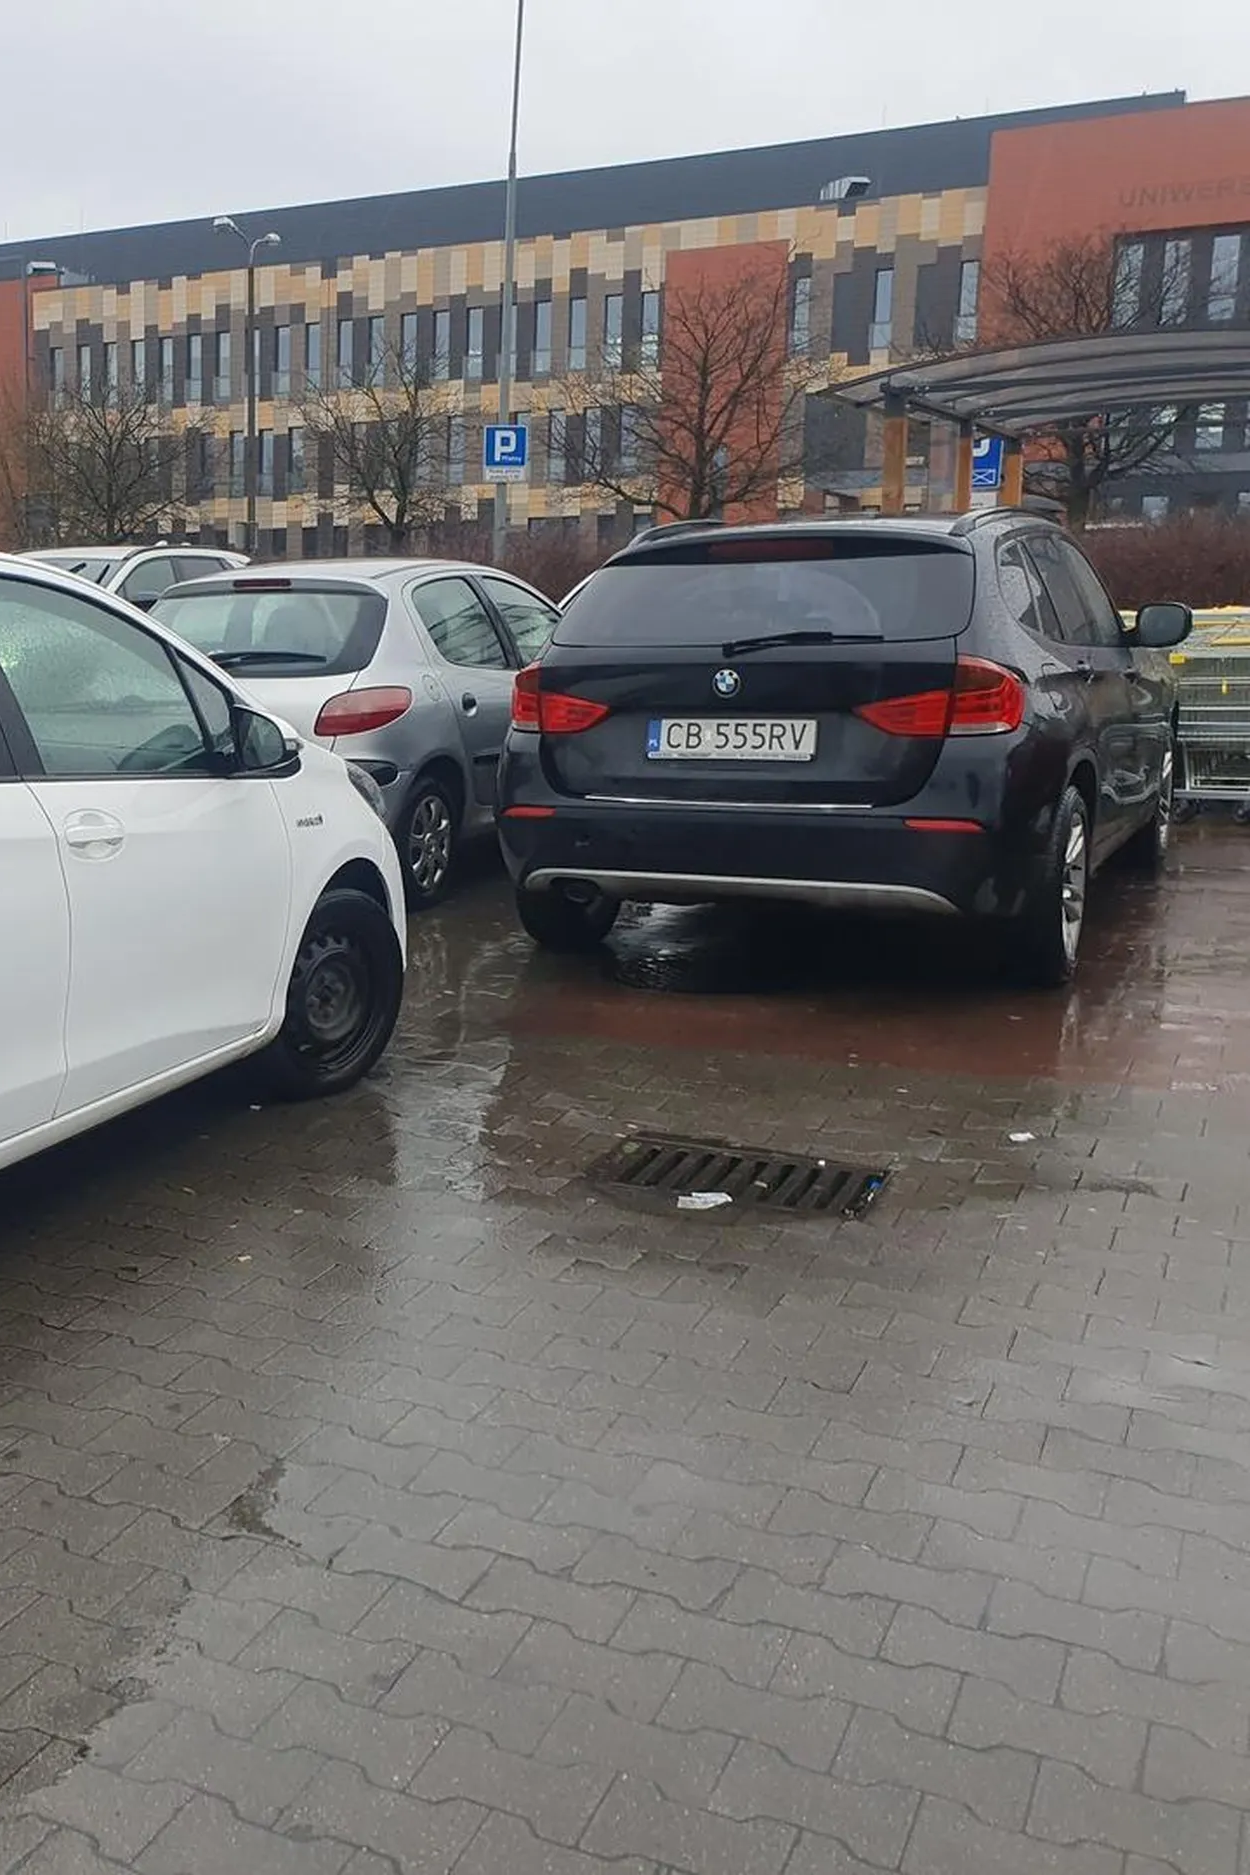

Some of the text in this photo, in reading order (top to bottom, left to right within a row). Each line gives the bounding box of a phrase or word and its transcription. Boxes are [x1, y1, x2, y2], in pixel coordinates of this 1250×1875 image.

[494, 430, 516, 462] P
[666, 723, 807, 750] CB 555RV
